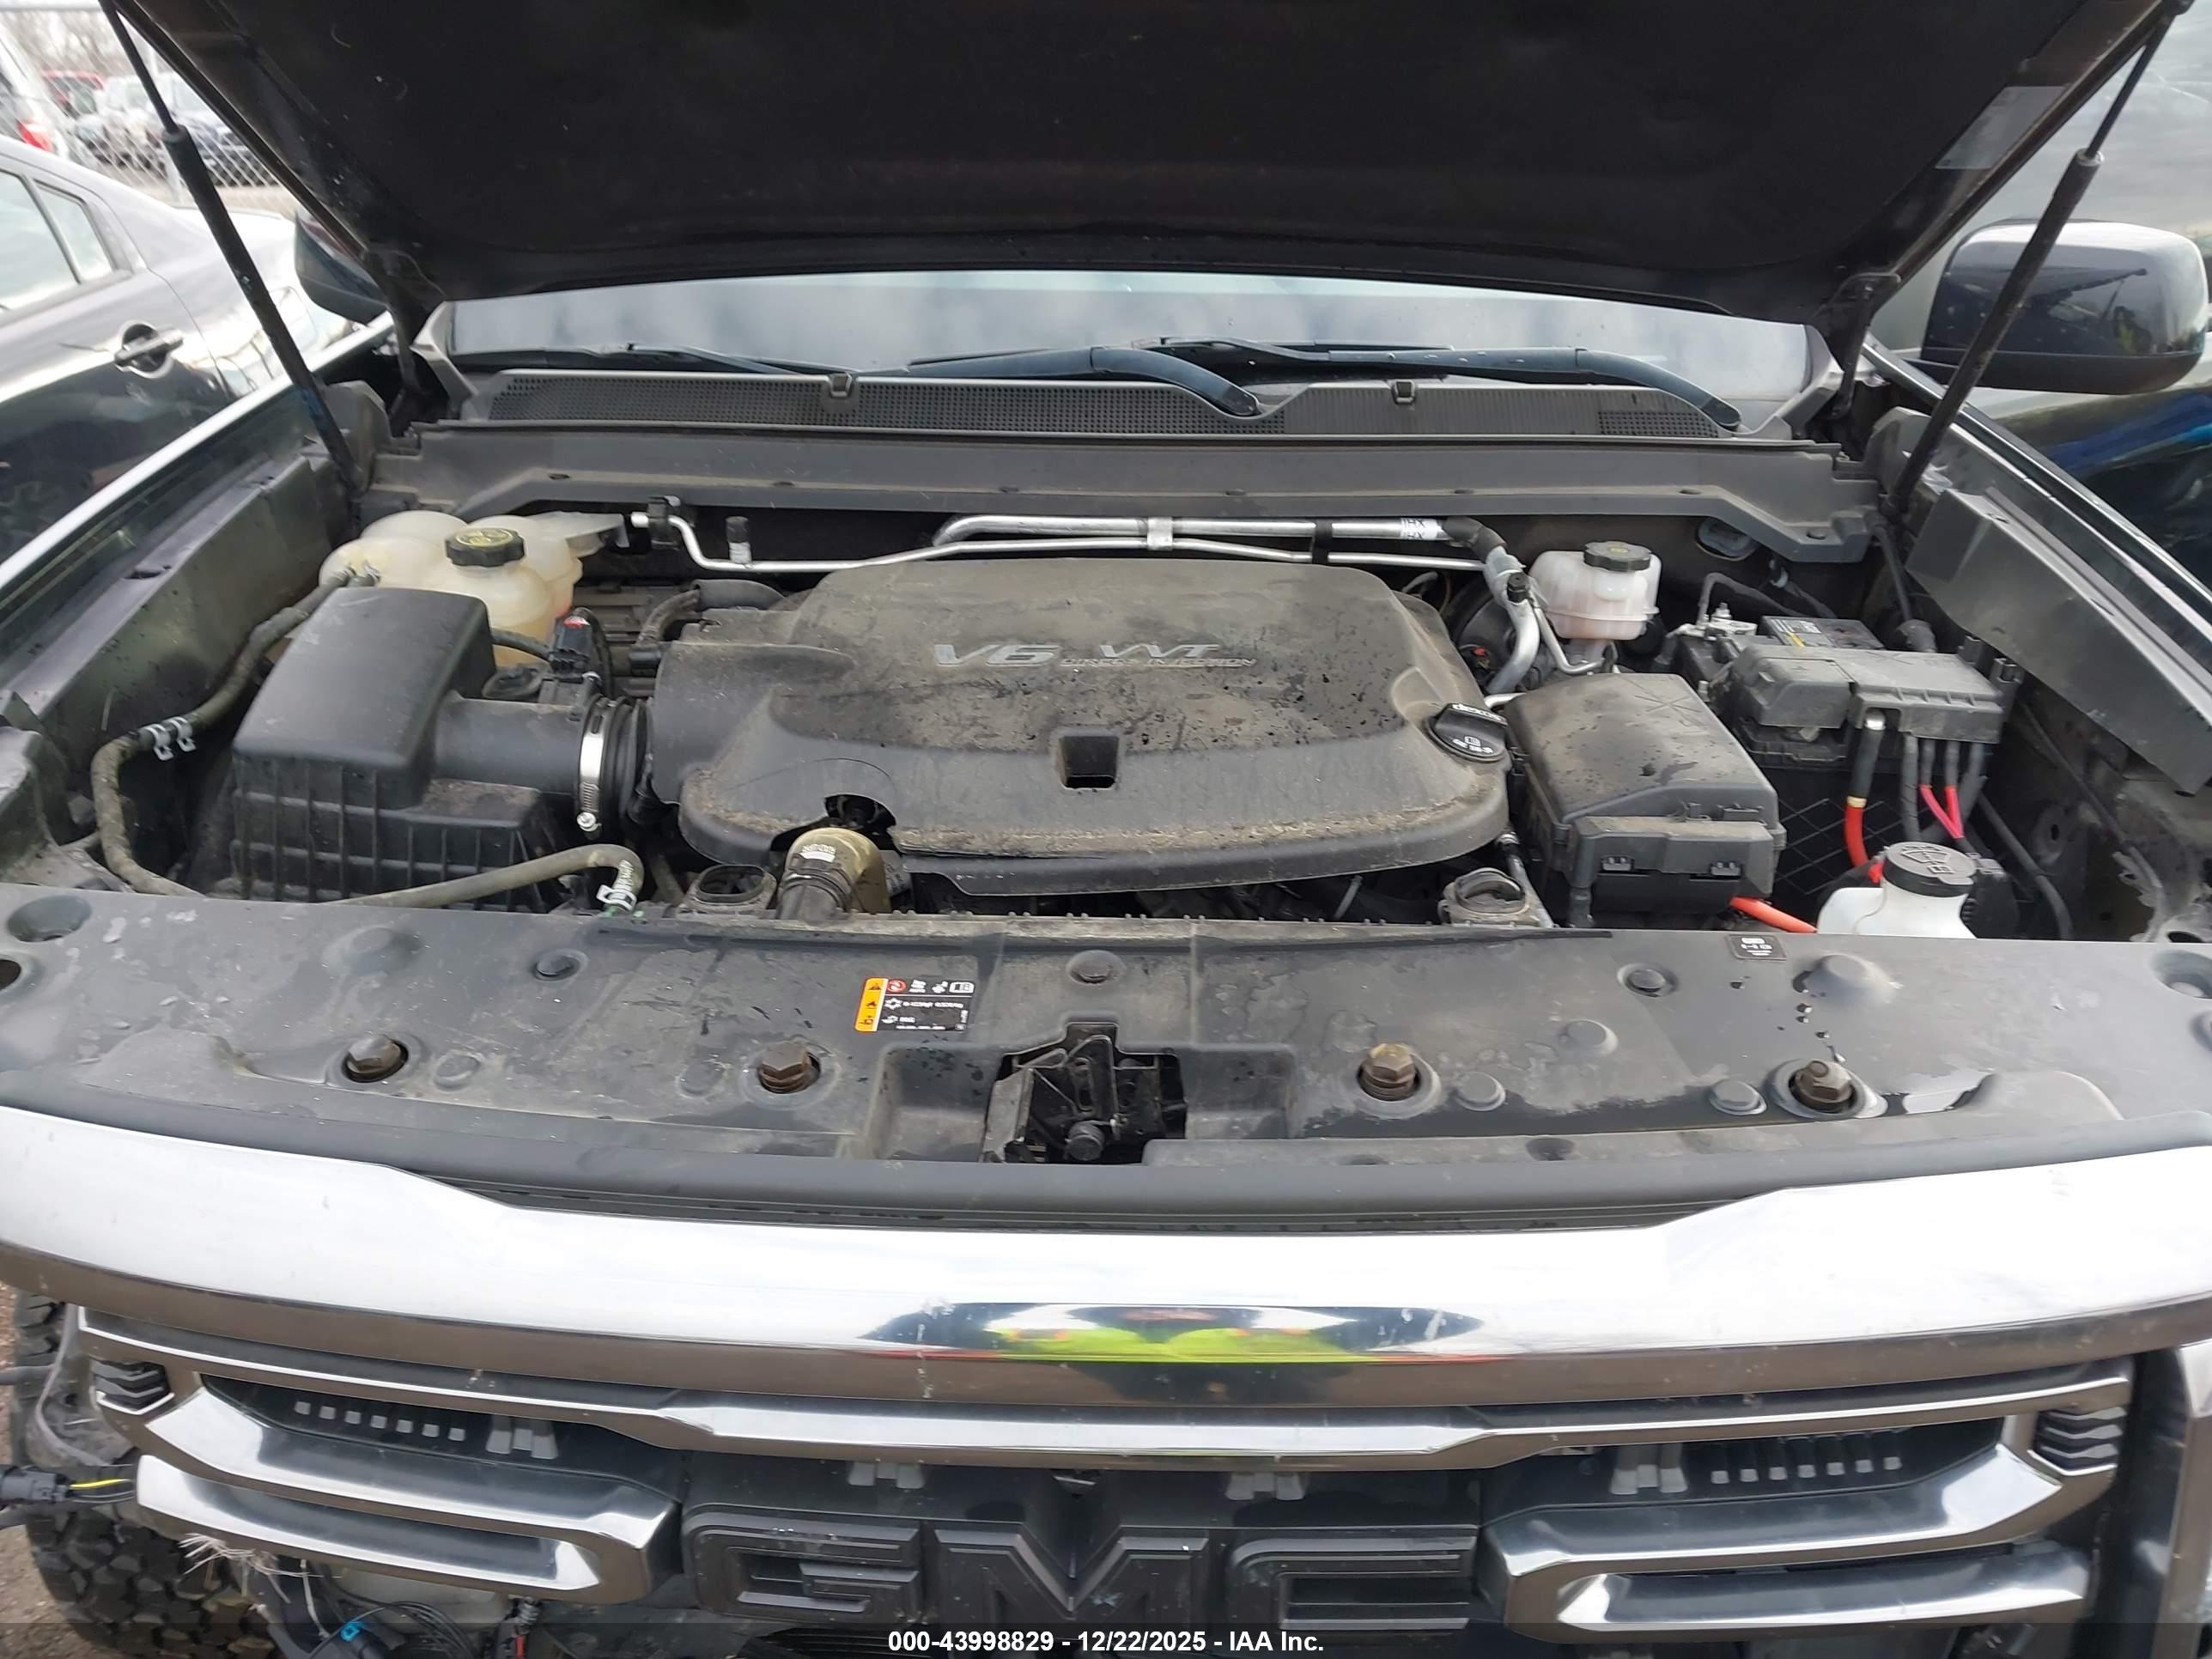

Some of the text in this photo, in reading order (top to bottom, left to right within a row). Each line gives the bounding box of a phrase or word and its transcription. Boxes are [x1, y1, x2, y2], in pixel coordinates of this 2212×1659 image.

[933, 644, 1220, 667] V6 VVT
[684, 1509, 1479, 1642] GMC
